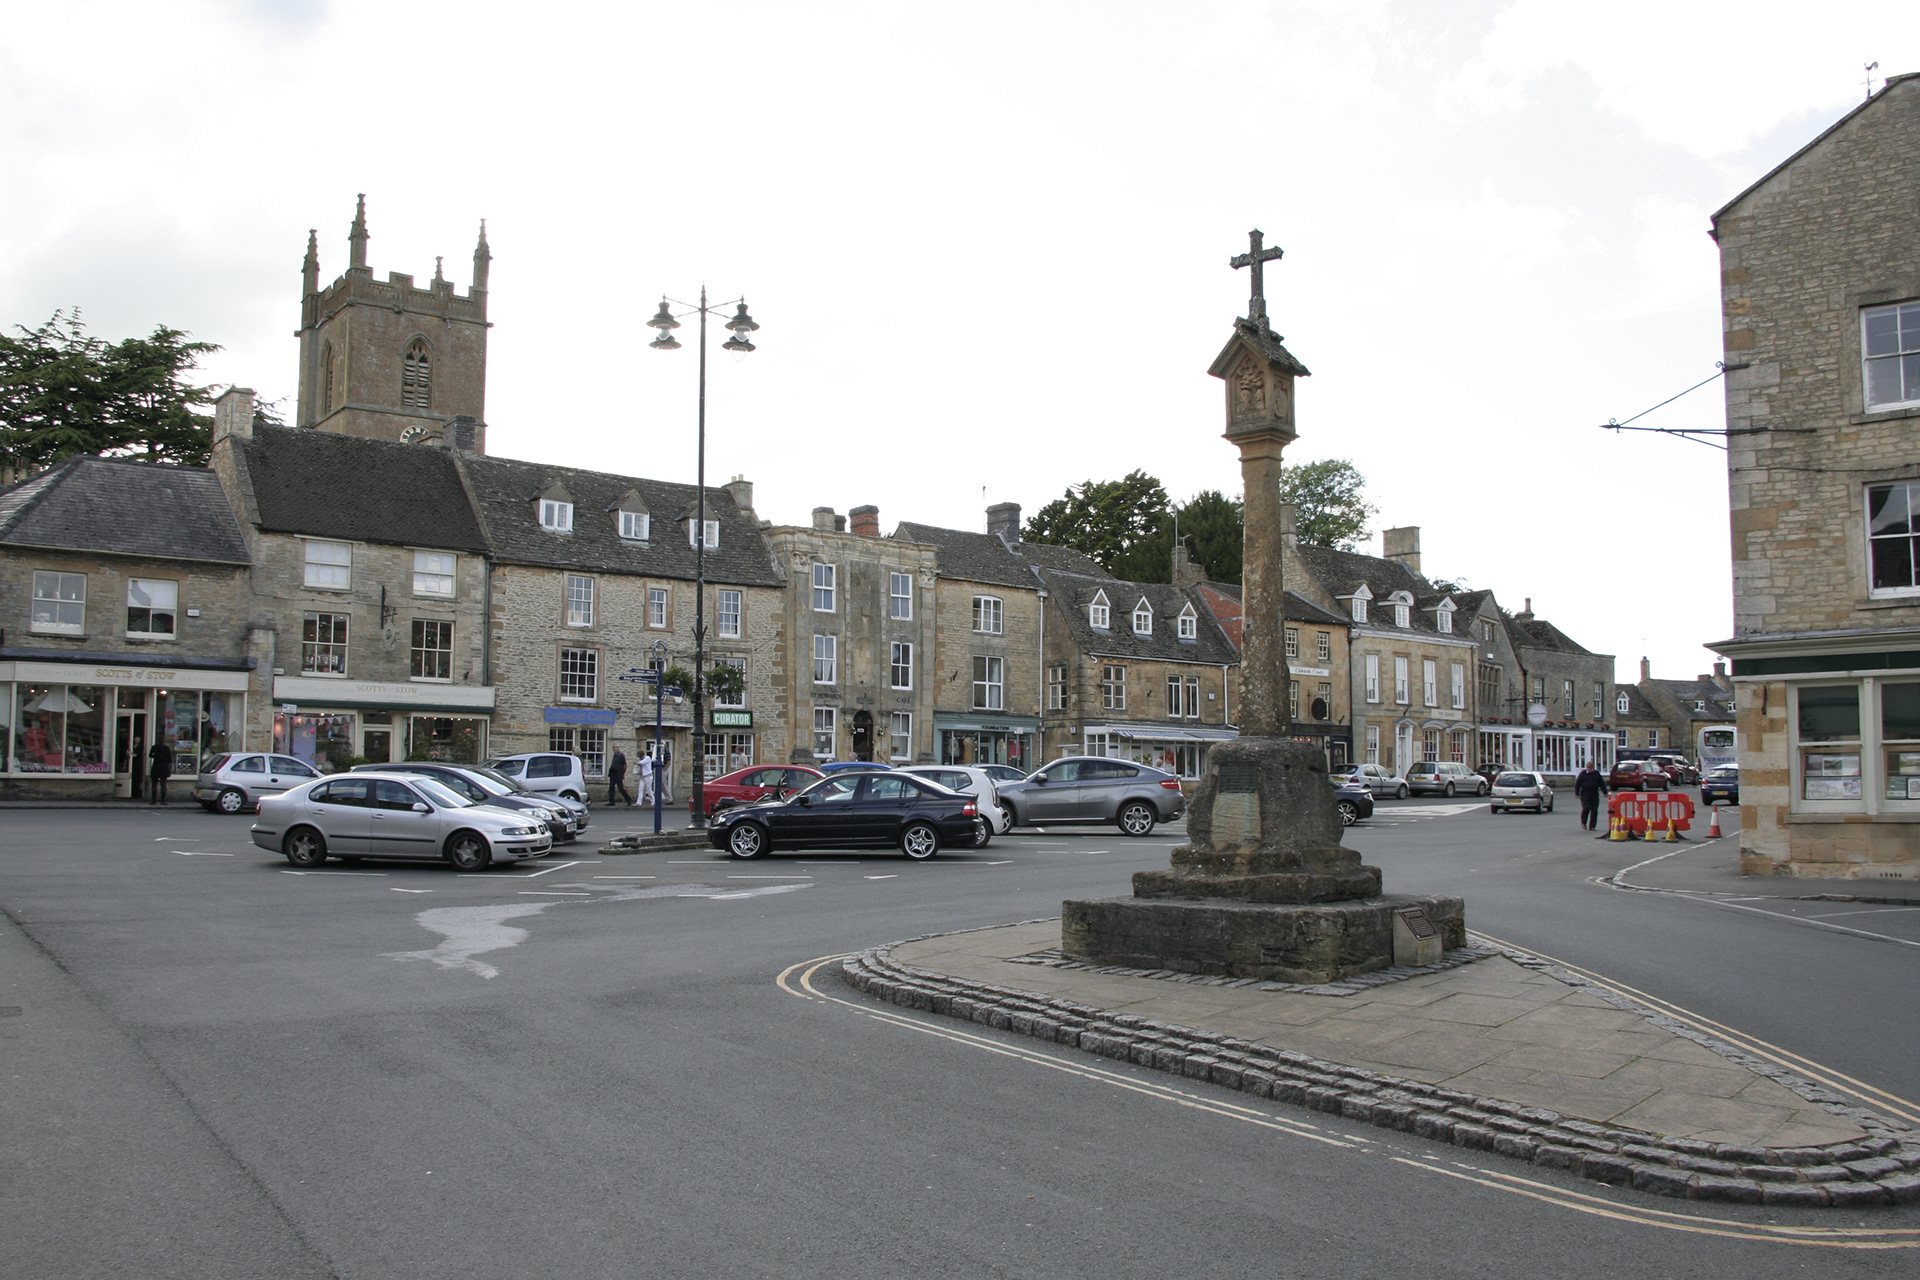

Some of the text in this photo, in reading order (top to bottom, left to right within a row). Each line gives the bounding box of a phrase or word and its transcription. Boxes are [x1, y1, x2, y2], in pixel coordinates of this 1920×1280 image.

[96, 668, 176, 680] SCOTTS of STOW
[547, 710, 614, 722] Cotswold Cards
[714, 713, 750, 725] CURATOR
